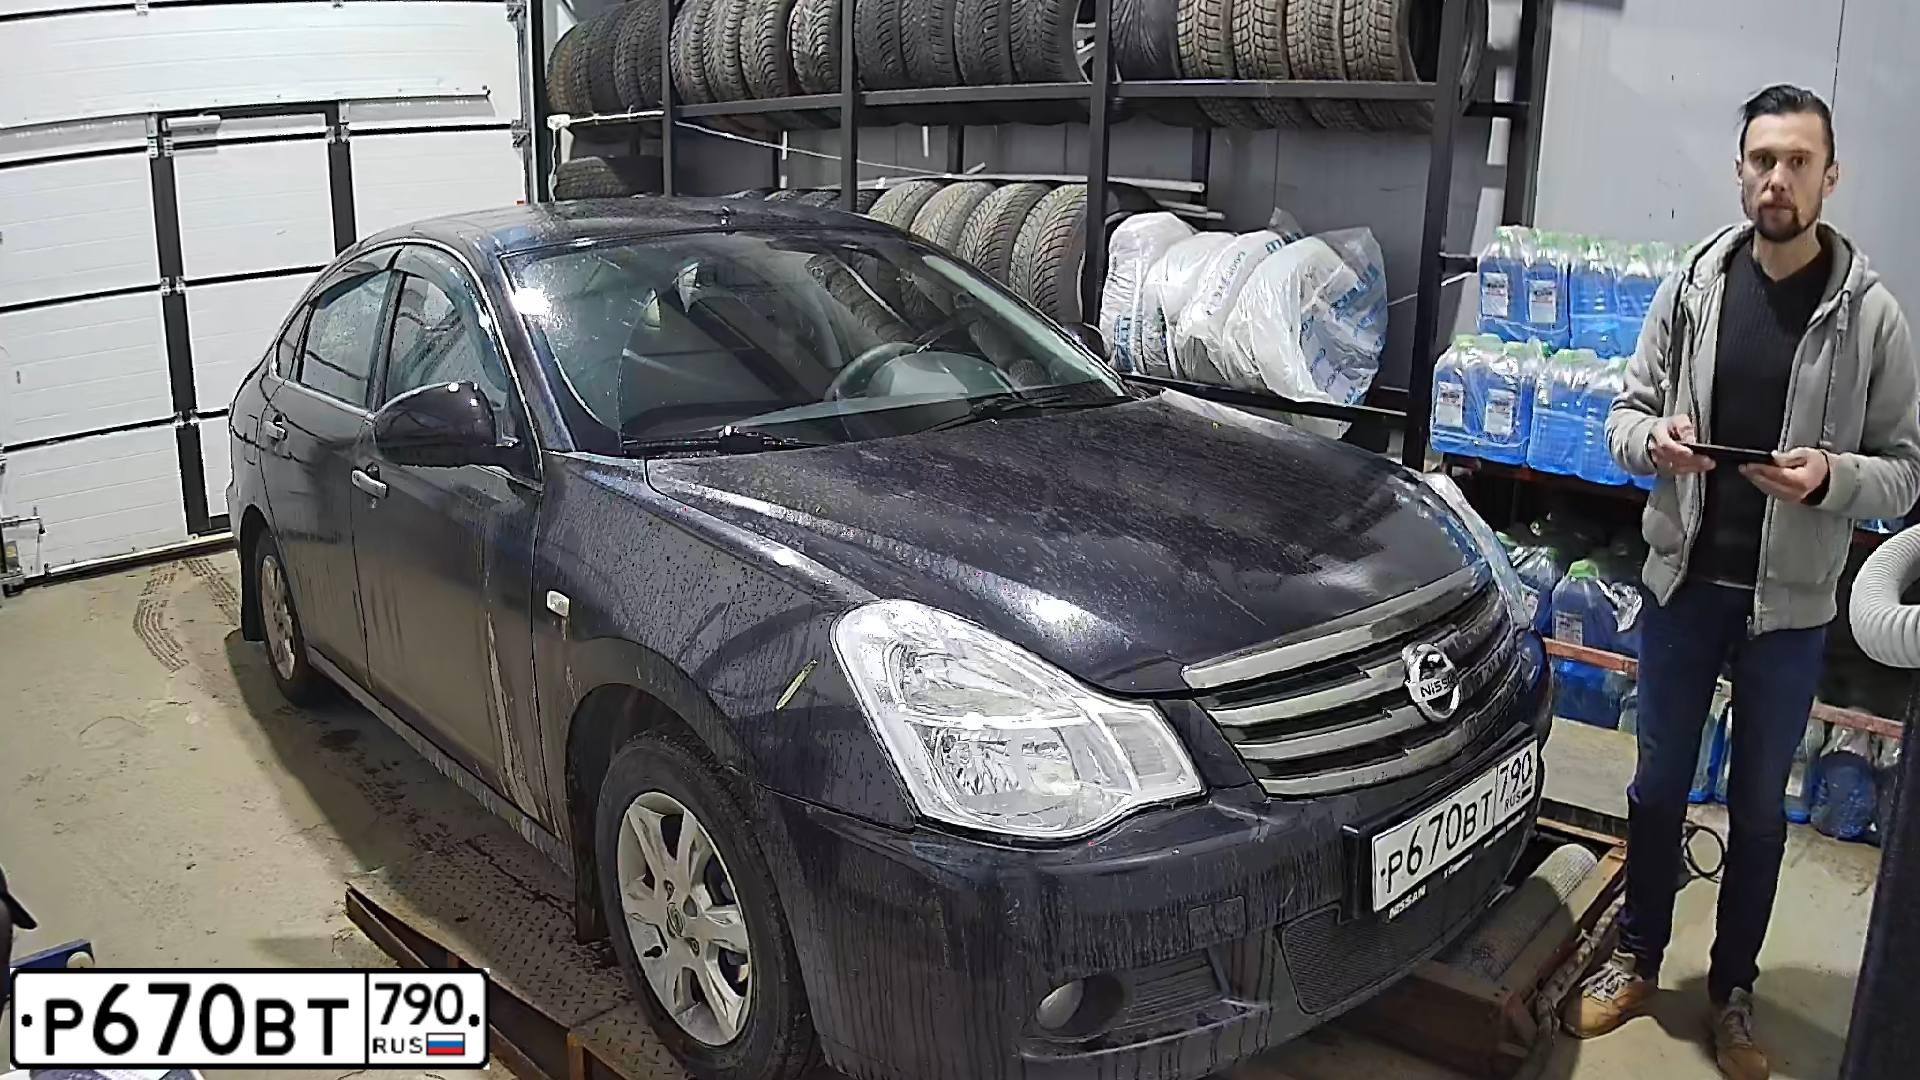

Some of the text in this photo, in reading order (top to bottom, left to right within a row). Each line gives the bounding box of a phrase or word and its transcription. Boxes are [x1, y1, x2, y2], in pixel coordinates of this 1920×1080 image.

[1420, 676, 1453, 698] NISS
[1499, 751, 1532, 803] 790
[1504, 791, 1522, 812] RUS
[1386, 789, 1493, 894] P670BT
